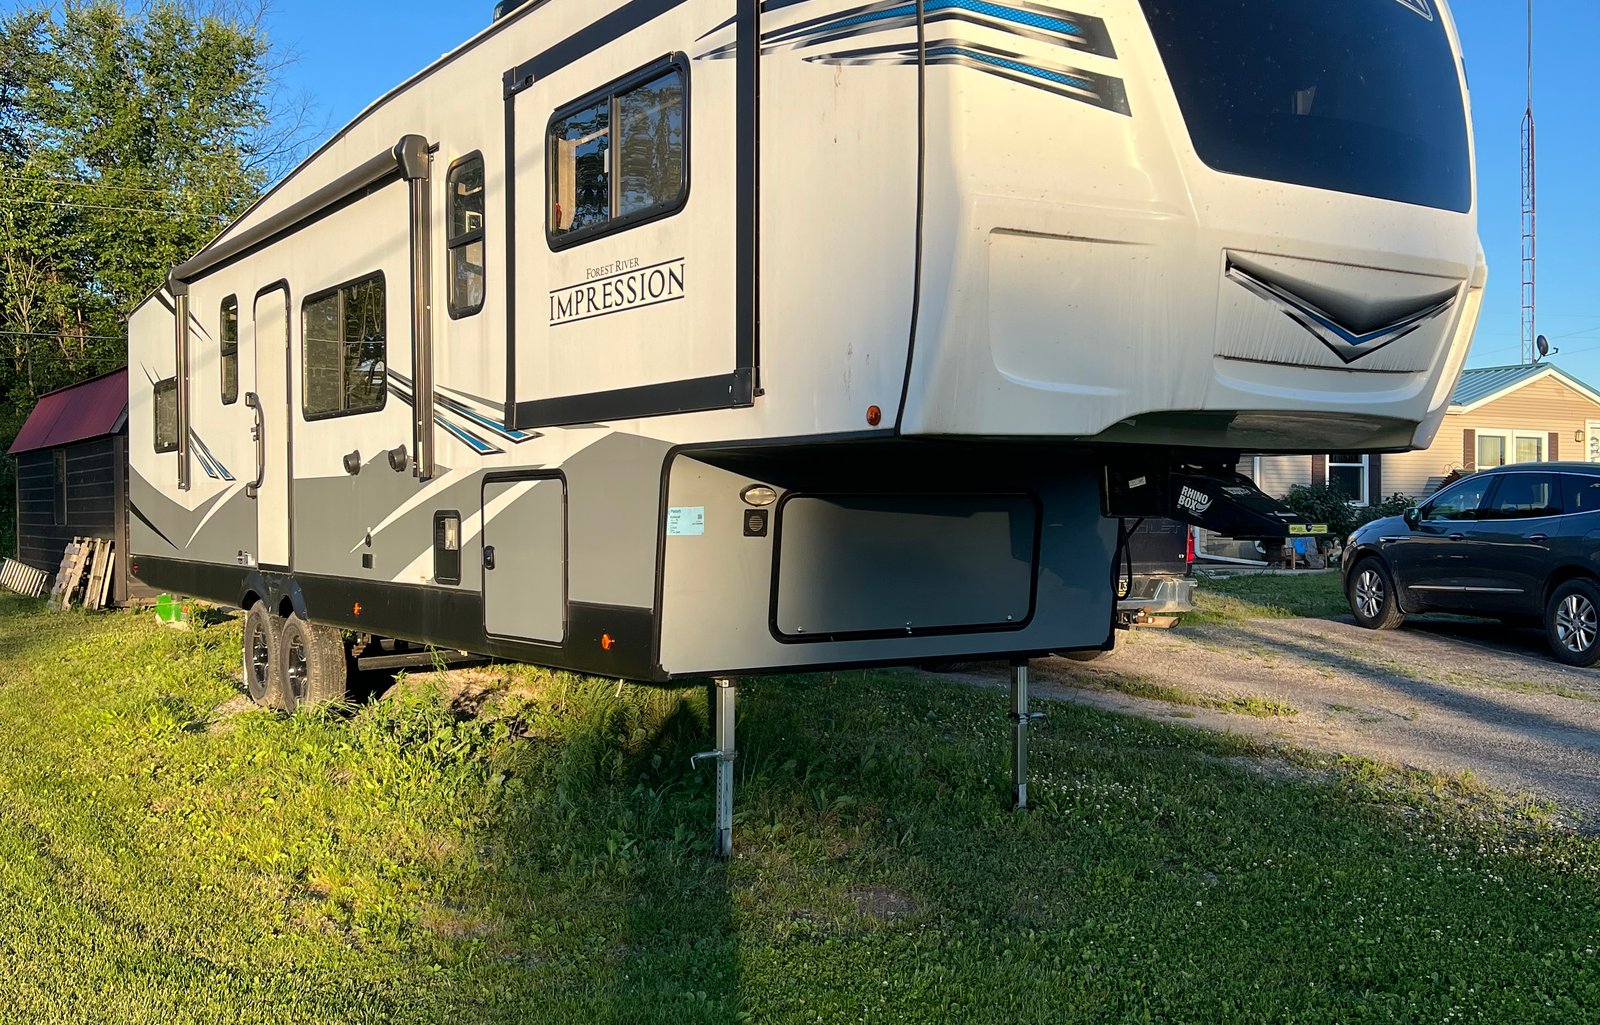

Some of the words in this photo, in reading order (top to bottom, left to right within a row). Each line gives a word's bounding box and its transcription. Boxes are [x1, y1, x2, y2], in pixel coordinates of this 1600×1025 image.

[586, 263, 614, 280] FOREST
[615, 257, 640, 272] RIVER
[549, 263, 686, 322] IMPRESSION
[1178, 494, 1198, 511] BOX
[1181, 485, 1209, 504] RHINO
